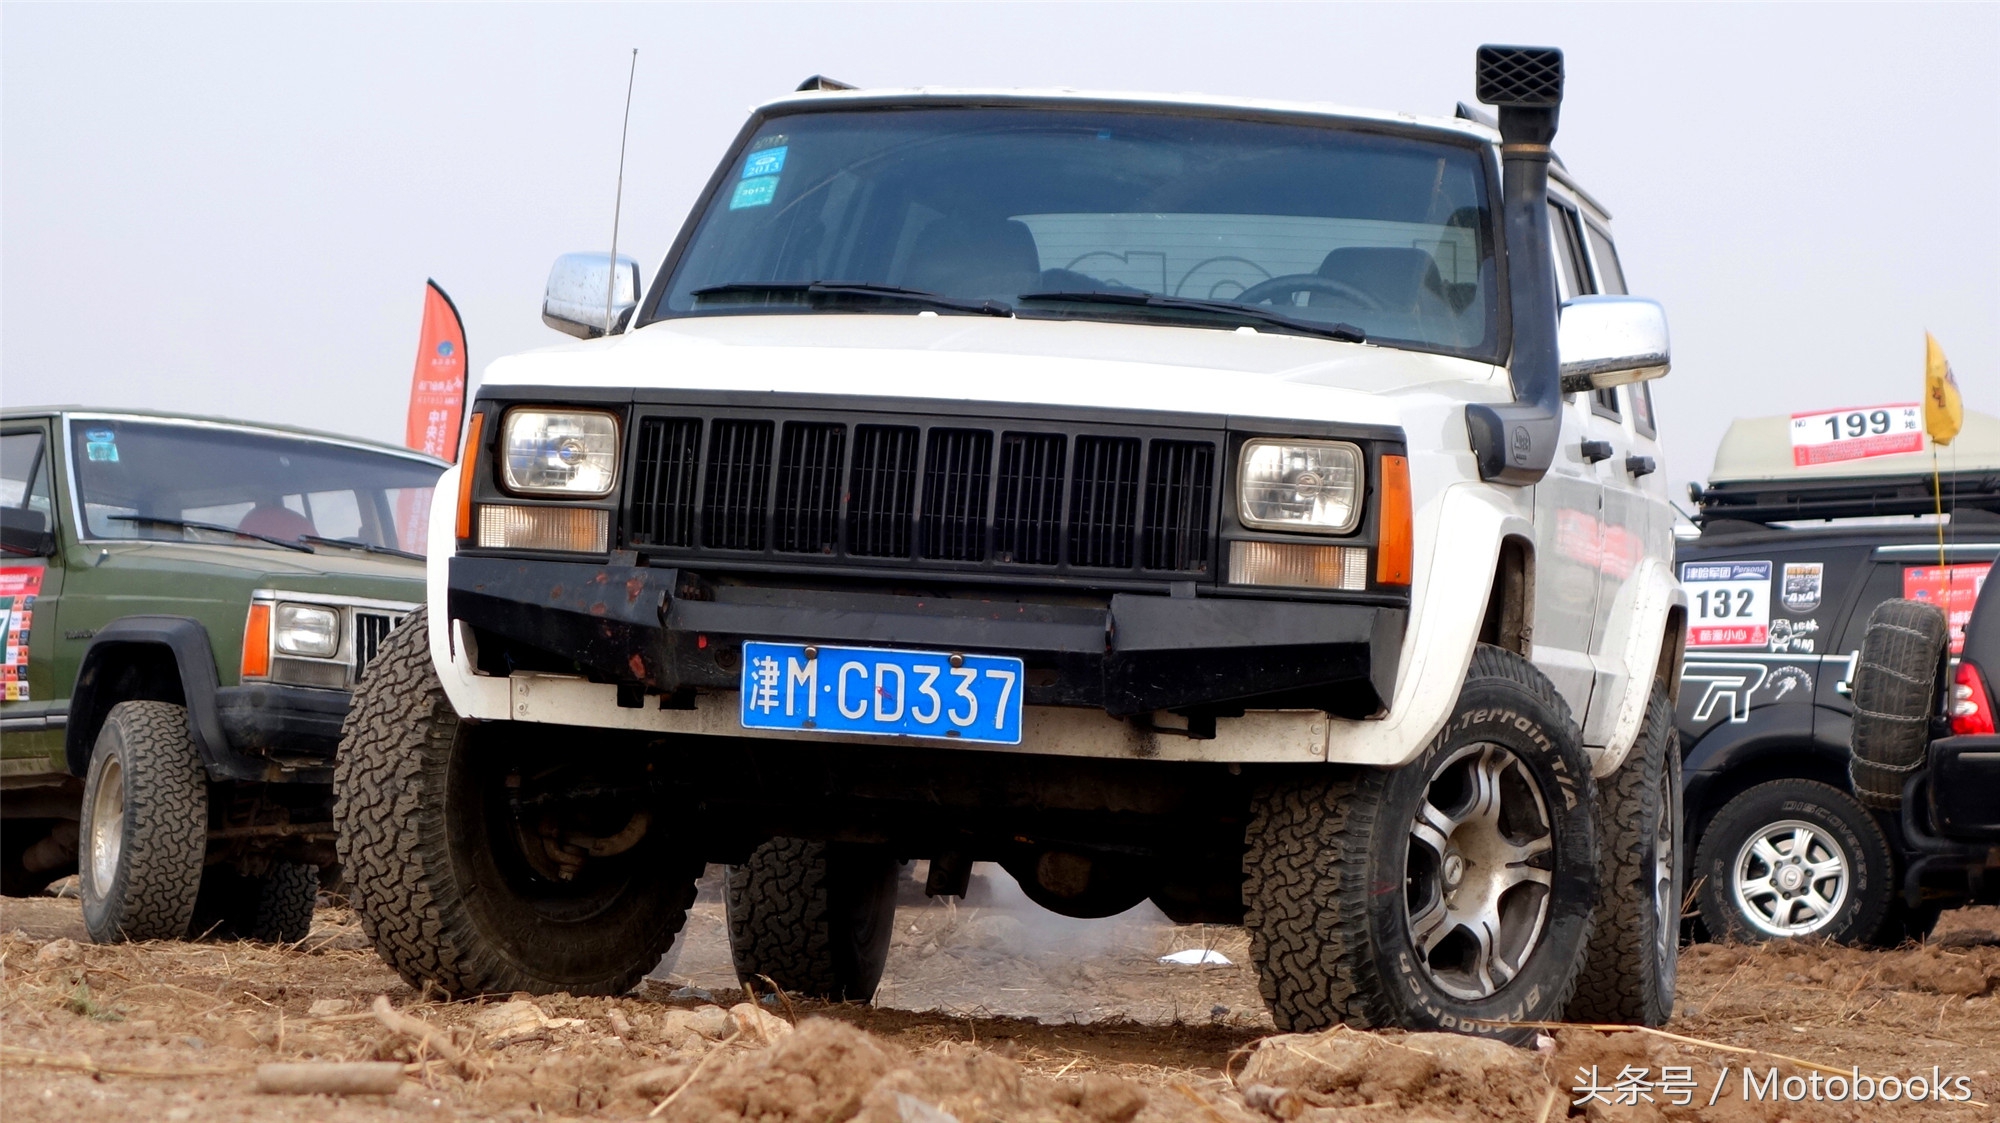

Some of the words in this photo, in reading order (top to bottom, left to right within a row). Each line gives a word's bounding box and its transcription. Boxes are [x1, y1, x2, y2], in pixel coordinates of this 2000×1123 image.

[1825, 410, 1891, 440] 199
[1733, 565, 1767, 574] Personal
[1696, 588, 1754, 618] 132
[750, 656, 1016, 730] 津M·CD337
[1551, 755, 1578, 811] T/A
[1782, 800, 1868, 891] DISCOVERER
